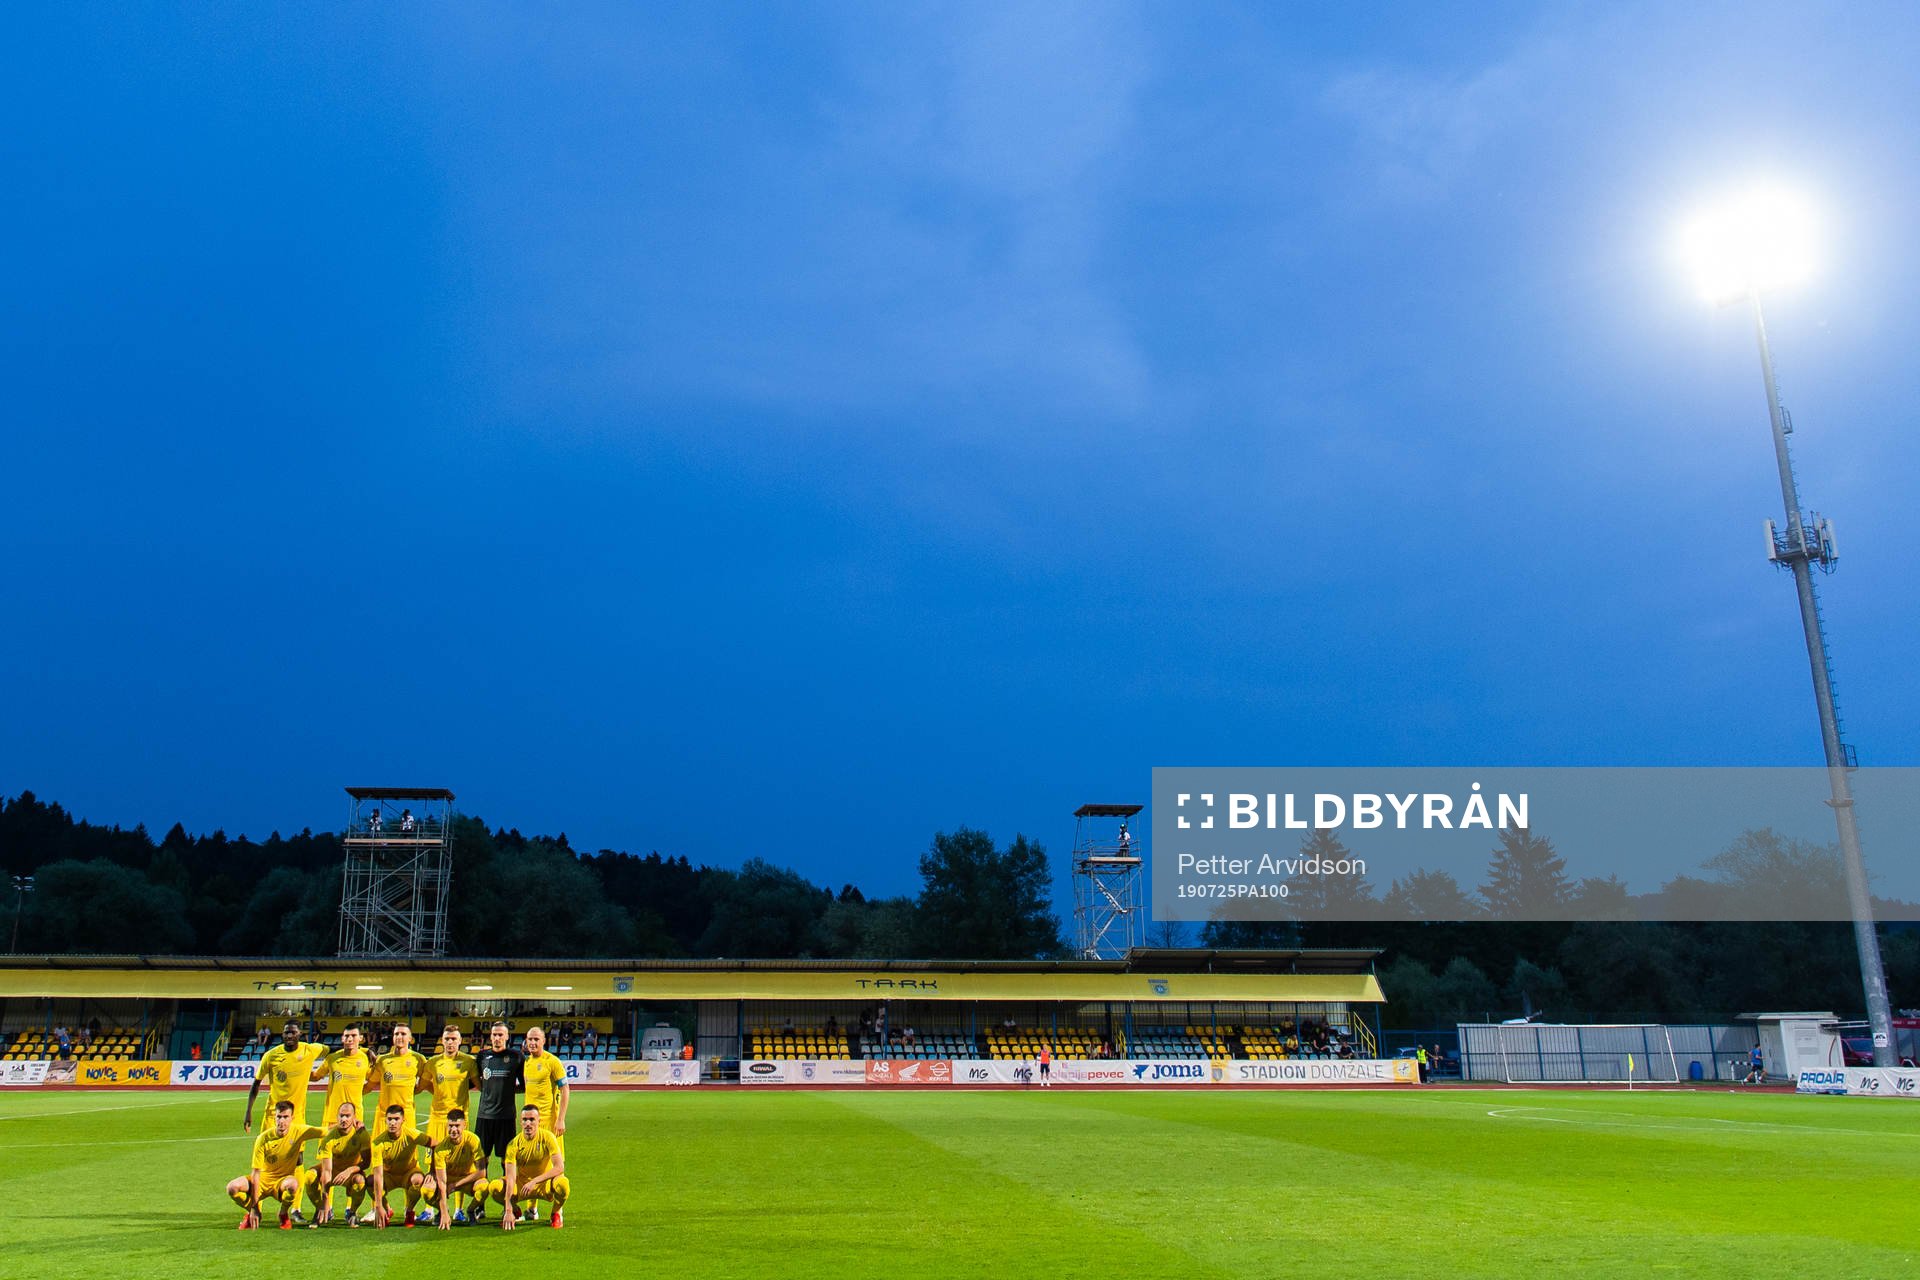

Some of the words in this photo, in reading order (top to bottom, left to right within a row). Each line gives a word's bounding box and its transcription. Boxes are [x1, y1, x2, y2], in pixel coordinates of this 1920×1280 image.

[856, 980, 937, 989] TARK
[872, 1061, 890, 1073] AS
[1240, 1065, 1306, 1079] STADION
[1311, 1064, 1385, 1079] DOMZALE
[969, 1068, 989, 1079] MG
[1014, 1068, 1033, 1079] MG
[1860, 1077, 1879, 1091] MG
[1897, 1077, 1915, 1091] MG
